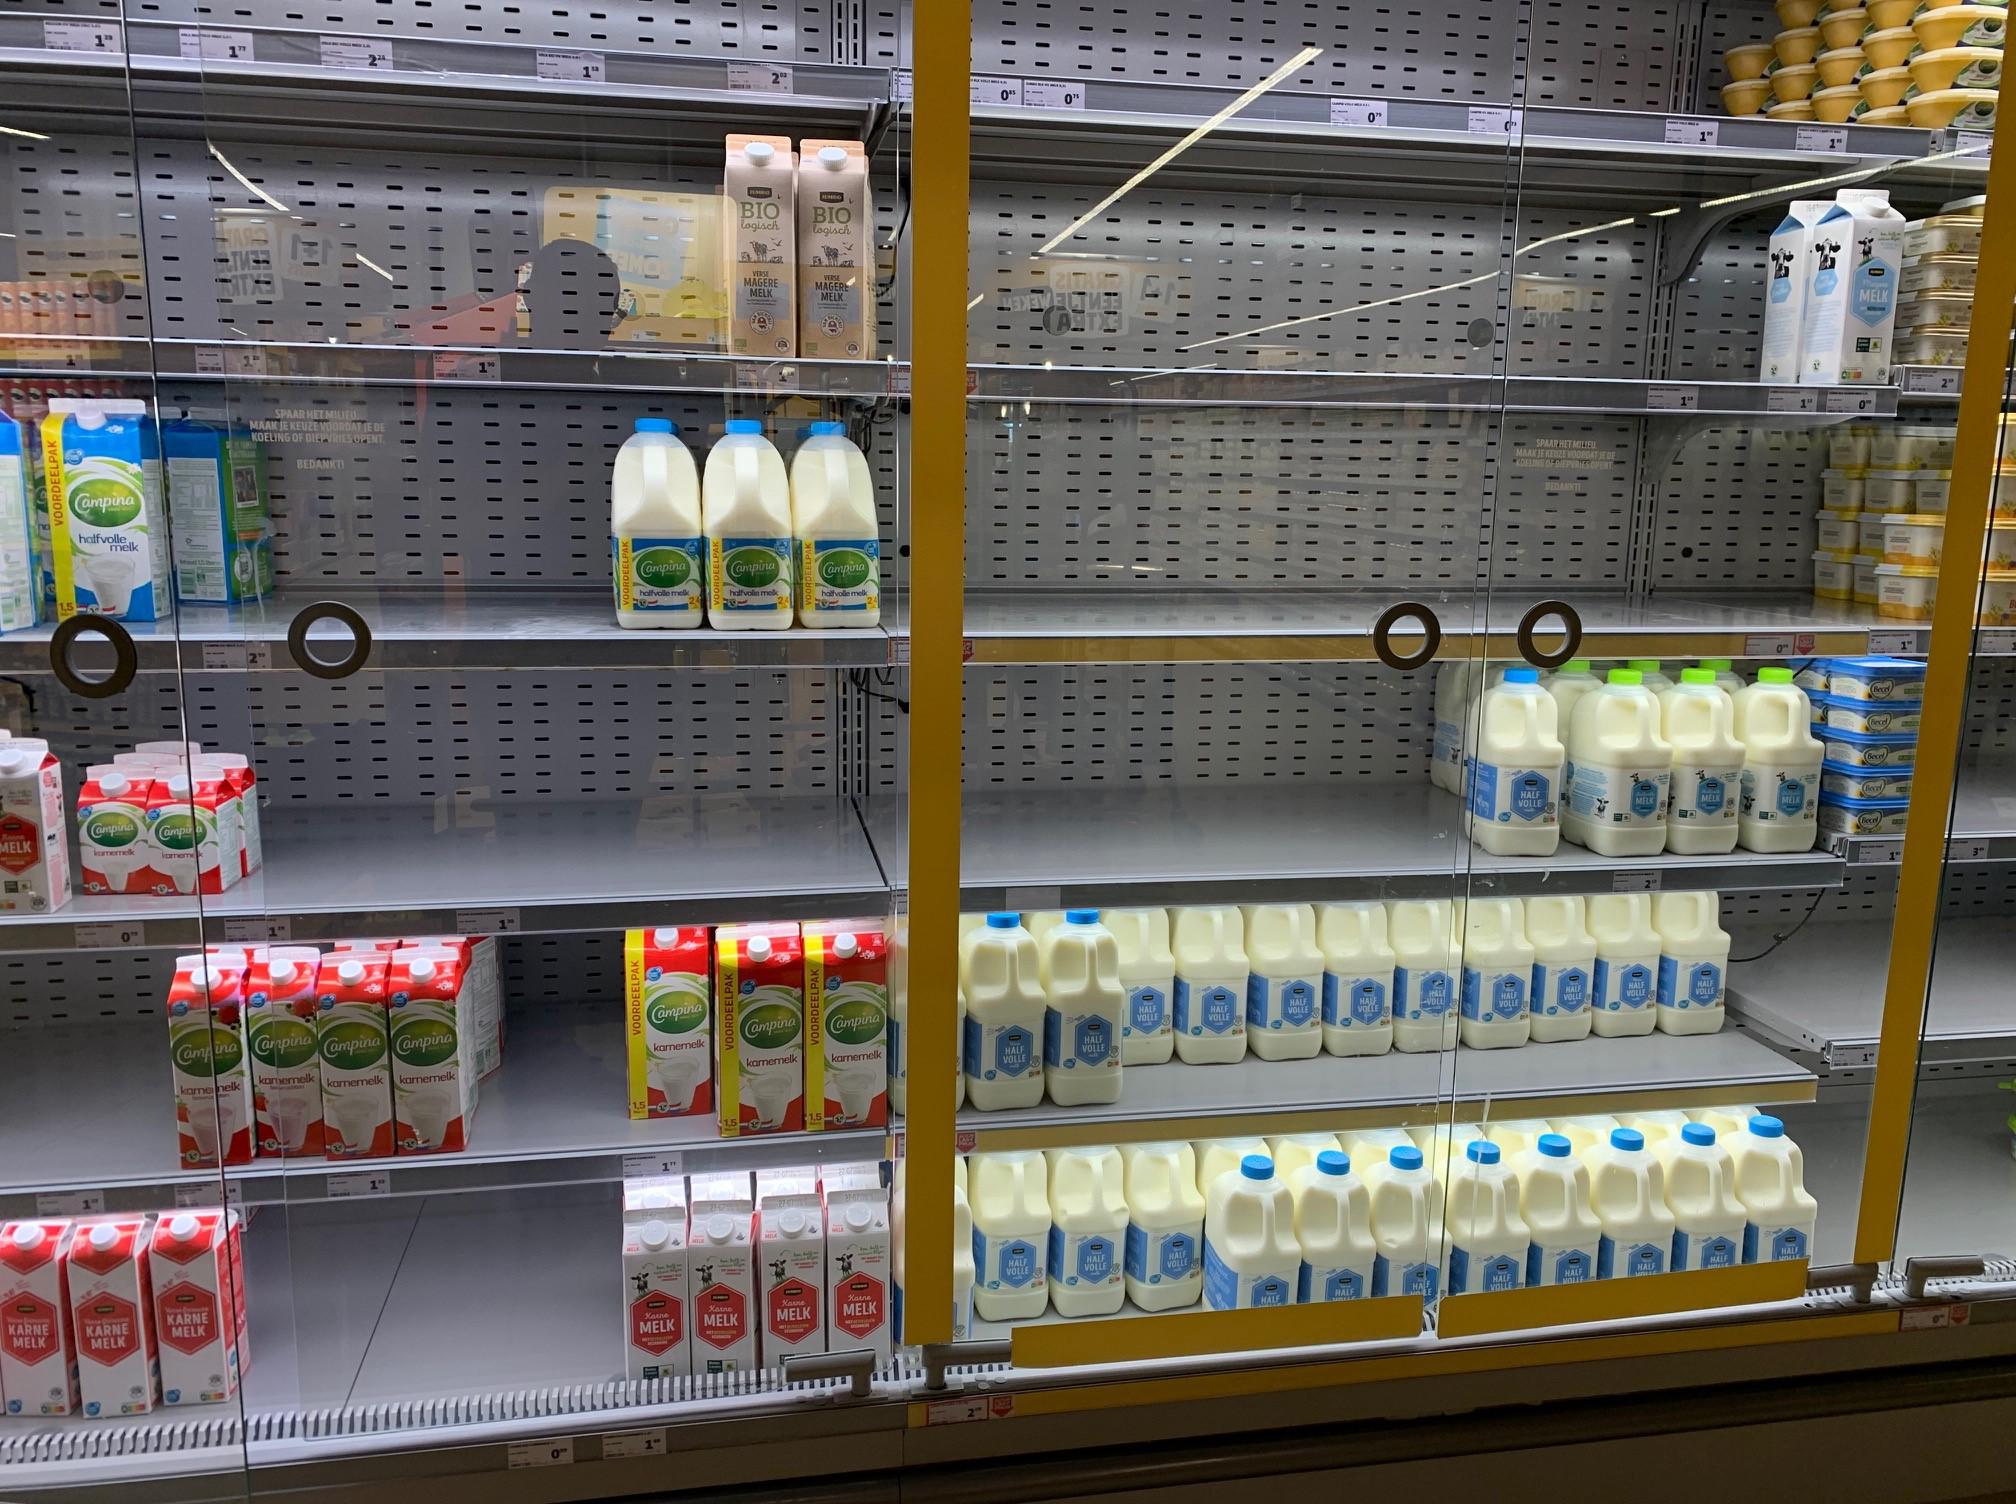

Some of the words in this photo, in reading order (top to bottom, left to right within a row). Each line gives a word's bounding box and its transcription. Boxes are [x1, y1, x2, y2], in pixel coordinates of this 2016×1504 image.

[740, 202, 780, 219] BIO
[812, 206, 851, 224] BIO
[740, 219, 780, 232] logisch
[812, 223, 851, 237] logisch
[743, 277, 779, 288] MAGERE
[815, 281, 849, 292] MAGERE
[749, 288, 773, 298] MELK
[820, 292, 844, 302] MELK
[1859, 289, 1889, 303] MELK
[275, 409, 305, 419] SPAAR
[250, 420, 278, 430] MAAK
[280, 421, 289, 432] JE
[290, 421, 318, 431] KEUZE
[251, 432, 291, 443] KOELING
[292, 433, 303, 443] OF
[1536, 439, 1558, 448] SPAAR
[47, 440, 64, 527] VOORDEELPAK
[75, 492, 135, 514] Campina
[79, 533, 128, 545] halfvolle
[110, 541, 139, 552] melk
[621, 540, 629, 607] VOORDEELPAK
[641, 559, 687, 578] Campina
[731, 559, 777, 578] Campina
[823, 560, 866, 579] Campina
[804, 541, 812, 608] VOORDEELPAK
[639, 589, 670, 598] halfvolle
[671, 589, 690, 598] melk
[729, 589, 760, 598] halfvolle
[761, 589, 779, 598] melk
[821, 589, 852, 598] halfvolle
[853, 590, 869, 598] melk
[59, 602, 74, 612] 1,5
[1873, 685, 1891, 694] Becel
[1870, 717, 1888, 726] Becel
[1867, 752, 1885, 760] Becel
[1865, 783, 1883, 791] Becel
[1520, 790, 1541, 800] HALF
[1781, 796, 1801, 804] MELK
[1517, 799, 1542, 808] VOLLE
[1635, 797, 1654, 806] MELK
[1861, 816, 1879, 824] Becel
[91, 823, 135, 839] Campina
[94, 848, 135, 857] karnemelk
[1628, 981, 1645, 989] HALF
[1697, 979, 1714, 987] HALF
[1565, 985, 1582, 993] HALF
[1626, 989, 1646, 997] VOLLE
[1695, 987, 1715, 995] VOLLE
[631, 960, 642, 1036] VOORDEELPAK
[1359, 996, 1377, 1004] HALF
[1500, 991, 1517, 999] HALF
[1563, 992, 1582, 1000] VOLLE
[810, 968, 821, 1046] VOORDEELPAK
[1289, 998, 1307, 1006] HALF
[1498, 999, 1519, 1007] VOLLE
[724, 973, 735, 1051] VOORDEELPAK
[1138, 1006, 1158, 1014] HALF
[1210, 1004, 1228, 1013] HALF
[1287, 1006, 1309, 1014] VOLLE
[1357, 1004, 1379, 1012] VOLLE
[651, 1003, 704, 1025] Campina
[1136, 1013, 1159, 1021] VOLLE
[1207, 1013, 1230, 1021] VOLLE
[745, 1016, 797, 1039] Campina
[830, 1014, 881, 1035] Campina
[255, 1033, 312, 1056] Campina
[396, 1033, 453, 1055] Campina
[1084, 1035, 1104, 1044] HALF
[323, 1038, 381, 1058] Campina
[653, 1039, 706, 1053] karnemelk
[1005, 1045, 1025, 1055] HALF
[1081, 1044, 1105, 1053] VOLLE
[746, 1054, 798, 1069] karnemelk
[831, 1050, 882, 1064] karnemelk
[1002, 1054, 1026, 1064] VOLLE
[258, 1073, 315, 1085] karnemelk
[326, 1075, 383, 1088] karnemelk
[399, 1071, 456, 1084] karnemelk
[632, 1101, 647, 1110] 1,5
[808, 1112, 823, 1122] 1,5
[723, 1118, 738, 1128] 1,5
[1168, 1251, 1186, 1259] HALF
[1781, 1247, 1799, 1255] HALF
[1008, 1259, 1028, 1268] HALF
[1086, 1255, 1105, 1263] HALF
[1166, 1259, 1188, 1268] VOLLE
[1710, 1255, 1729, 1263] HALF
[1006, 1267, 1029, 1276] VOLLE
[1084, 1263, 1107, 1271] VOLLE
[1637, 1263, 1656, 1271] HALF
[1564, 1268, 1583, 1277] HALF
[1492, 1274, 1512, 1282] HALF
[848, 1293, 872, 1302] Karne
[1335, 1288, 1355, 1297] HALF
[781, 1298, 806, 1306] Karne
[1260, 1295, 1280, 1304] HALF
[708, 1304, 733, 1312] Karne
[842, 1301, 877, 1316] MELK
[644, 1312, 669, 1320] Karne
[776, 1306, 811, 1321] MELK
[167, 1312, 209, 1326] KARNE
[703, 1313, 738, 1327] MELK
[8, 1323, 49, 1337] KARNE
[86, 1322, 129, 1337] KARNE
[639, 1318, 675, 1334] MELK
[171, 1325, 206, 1338] MELK
[13, 1336, 47, 1350] MELK
[91, 1336, 127, 1350] MELK
